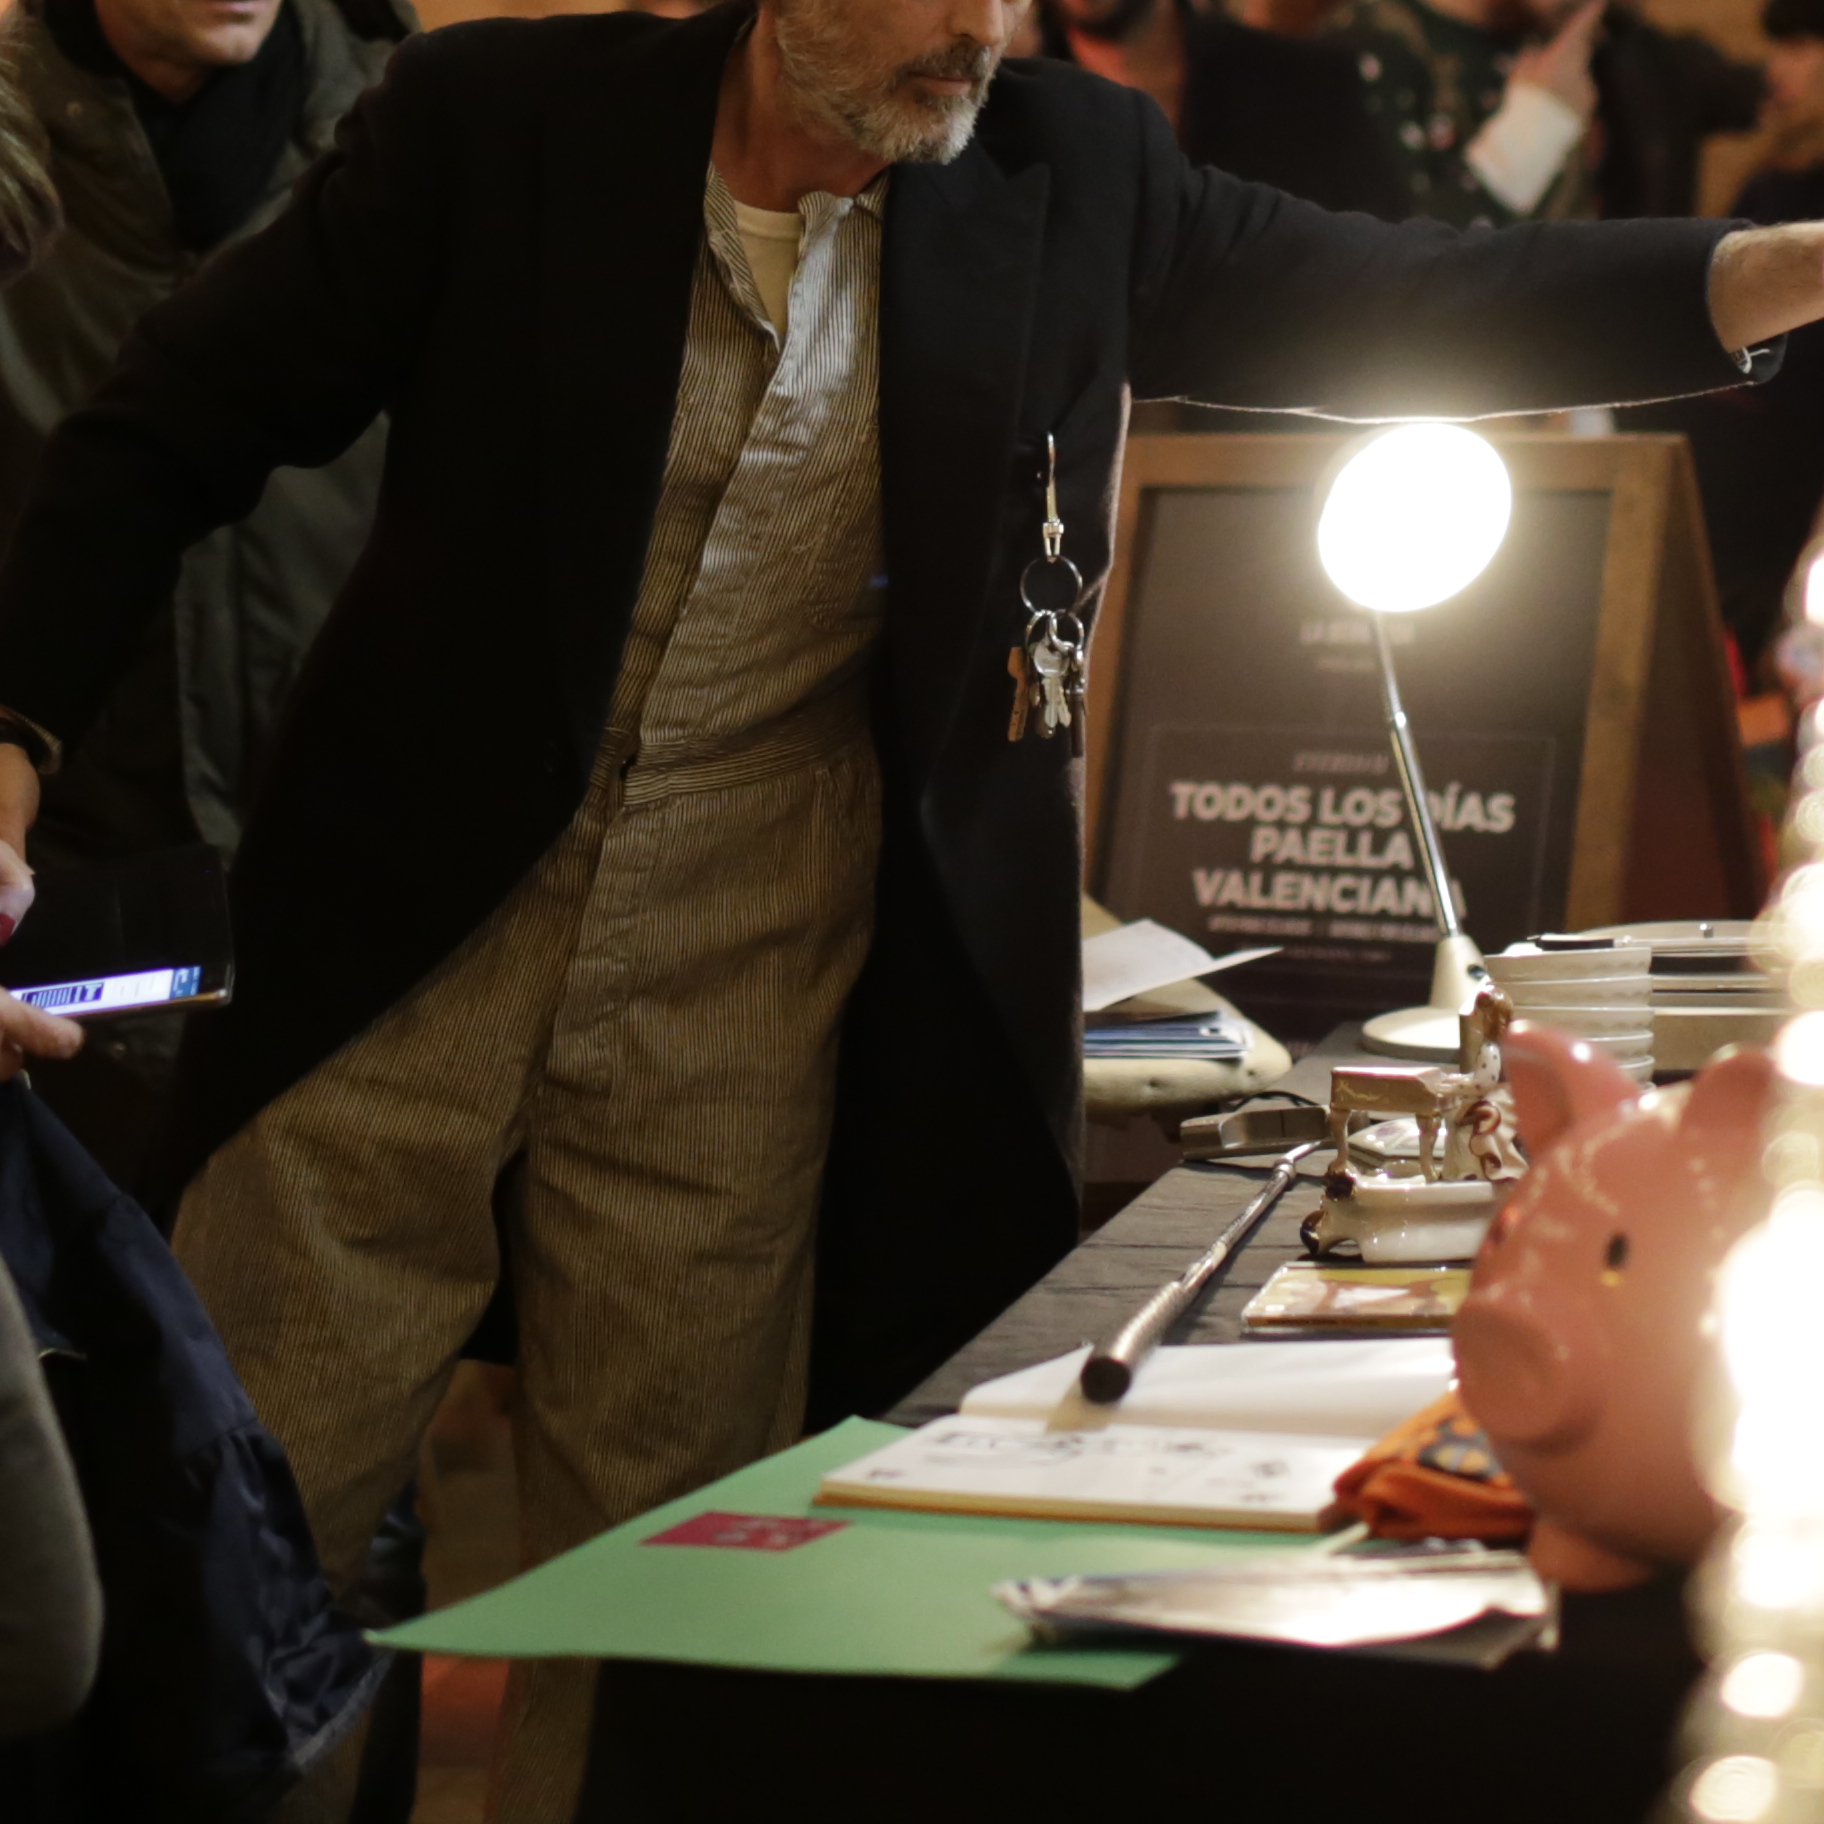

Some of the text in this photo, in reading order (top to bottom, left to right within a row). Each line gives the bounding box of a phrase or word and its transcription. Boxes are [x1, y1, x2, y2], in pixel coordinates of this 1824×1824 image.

[1171, 781, 1312, 823] TODOS
[1318, 787, 1403, 827] LOS
[1248, 826, 1415, 871] PAELLA
